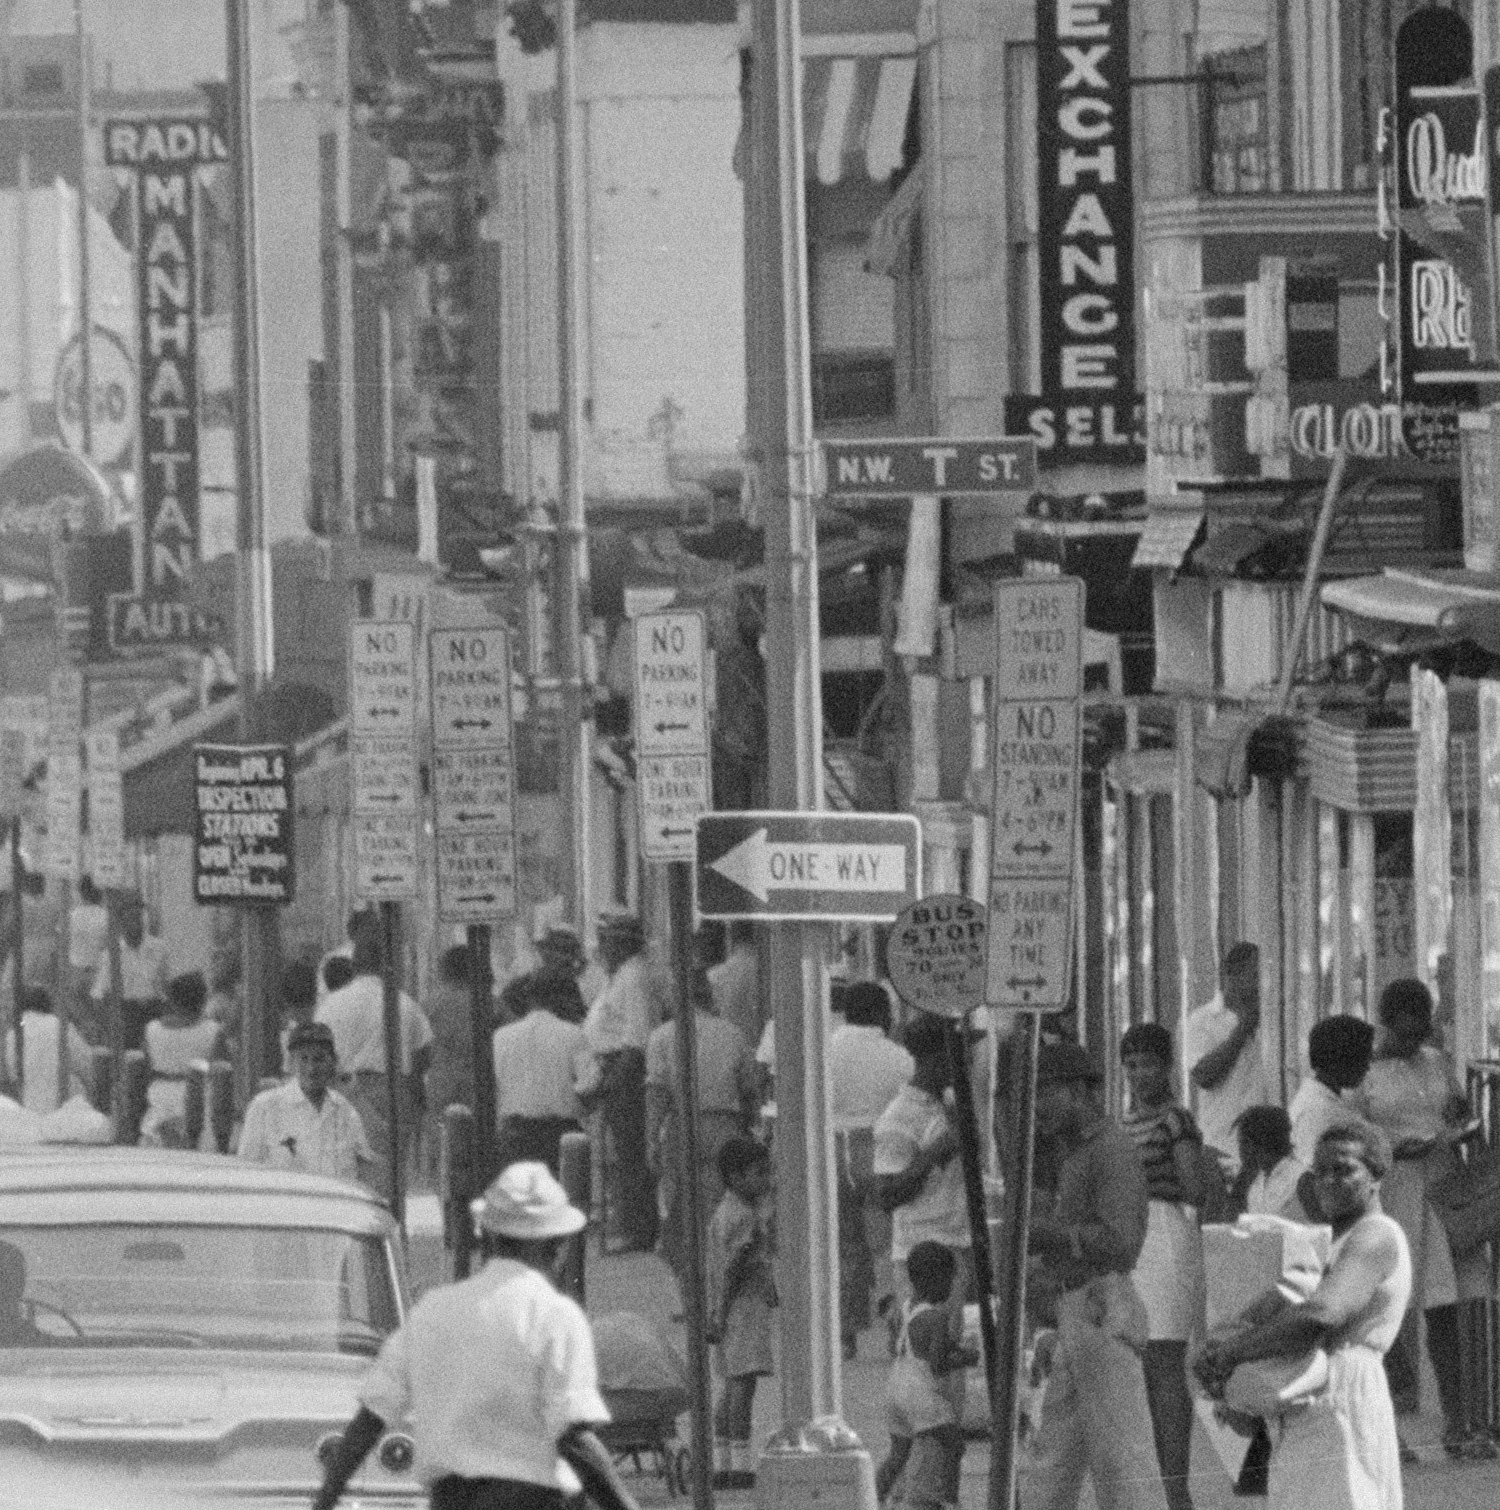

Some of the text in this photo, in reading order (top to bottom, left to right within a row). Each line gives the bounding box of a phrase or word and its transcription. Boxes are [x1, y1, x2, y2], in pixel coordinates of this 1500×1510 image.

[1055, 0, 1119, 390] EXCHANGE
[144, 174, 192, 586] MANHATTAN
[1289, 402, 1402, 460] CLOT
[838, 448, 1020, 487] N.W. T ST.
[1018, 596, 1060, 622] CARS
[367, 633, 397, 654] NO
[449, 638, 487, 662] NO
[652, 626, 685, 655] NO
[1012, 628, 1066, 654] TOWED
[436, 669, 501, 688] PARKING
[1017, 662, 1059, 687] AWAY
[1016, 704, 1056, 740] NO
[1001, 742, 1072, 767] STANDING
[768, 852, 882, 883] ONE WAY
[912, 903, 975, 925] BUS
[902, 921, 985, 947] STOP
[1011, 917, 1045, 940] ANY
[1010, 943, 1046, 967] TIME
